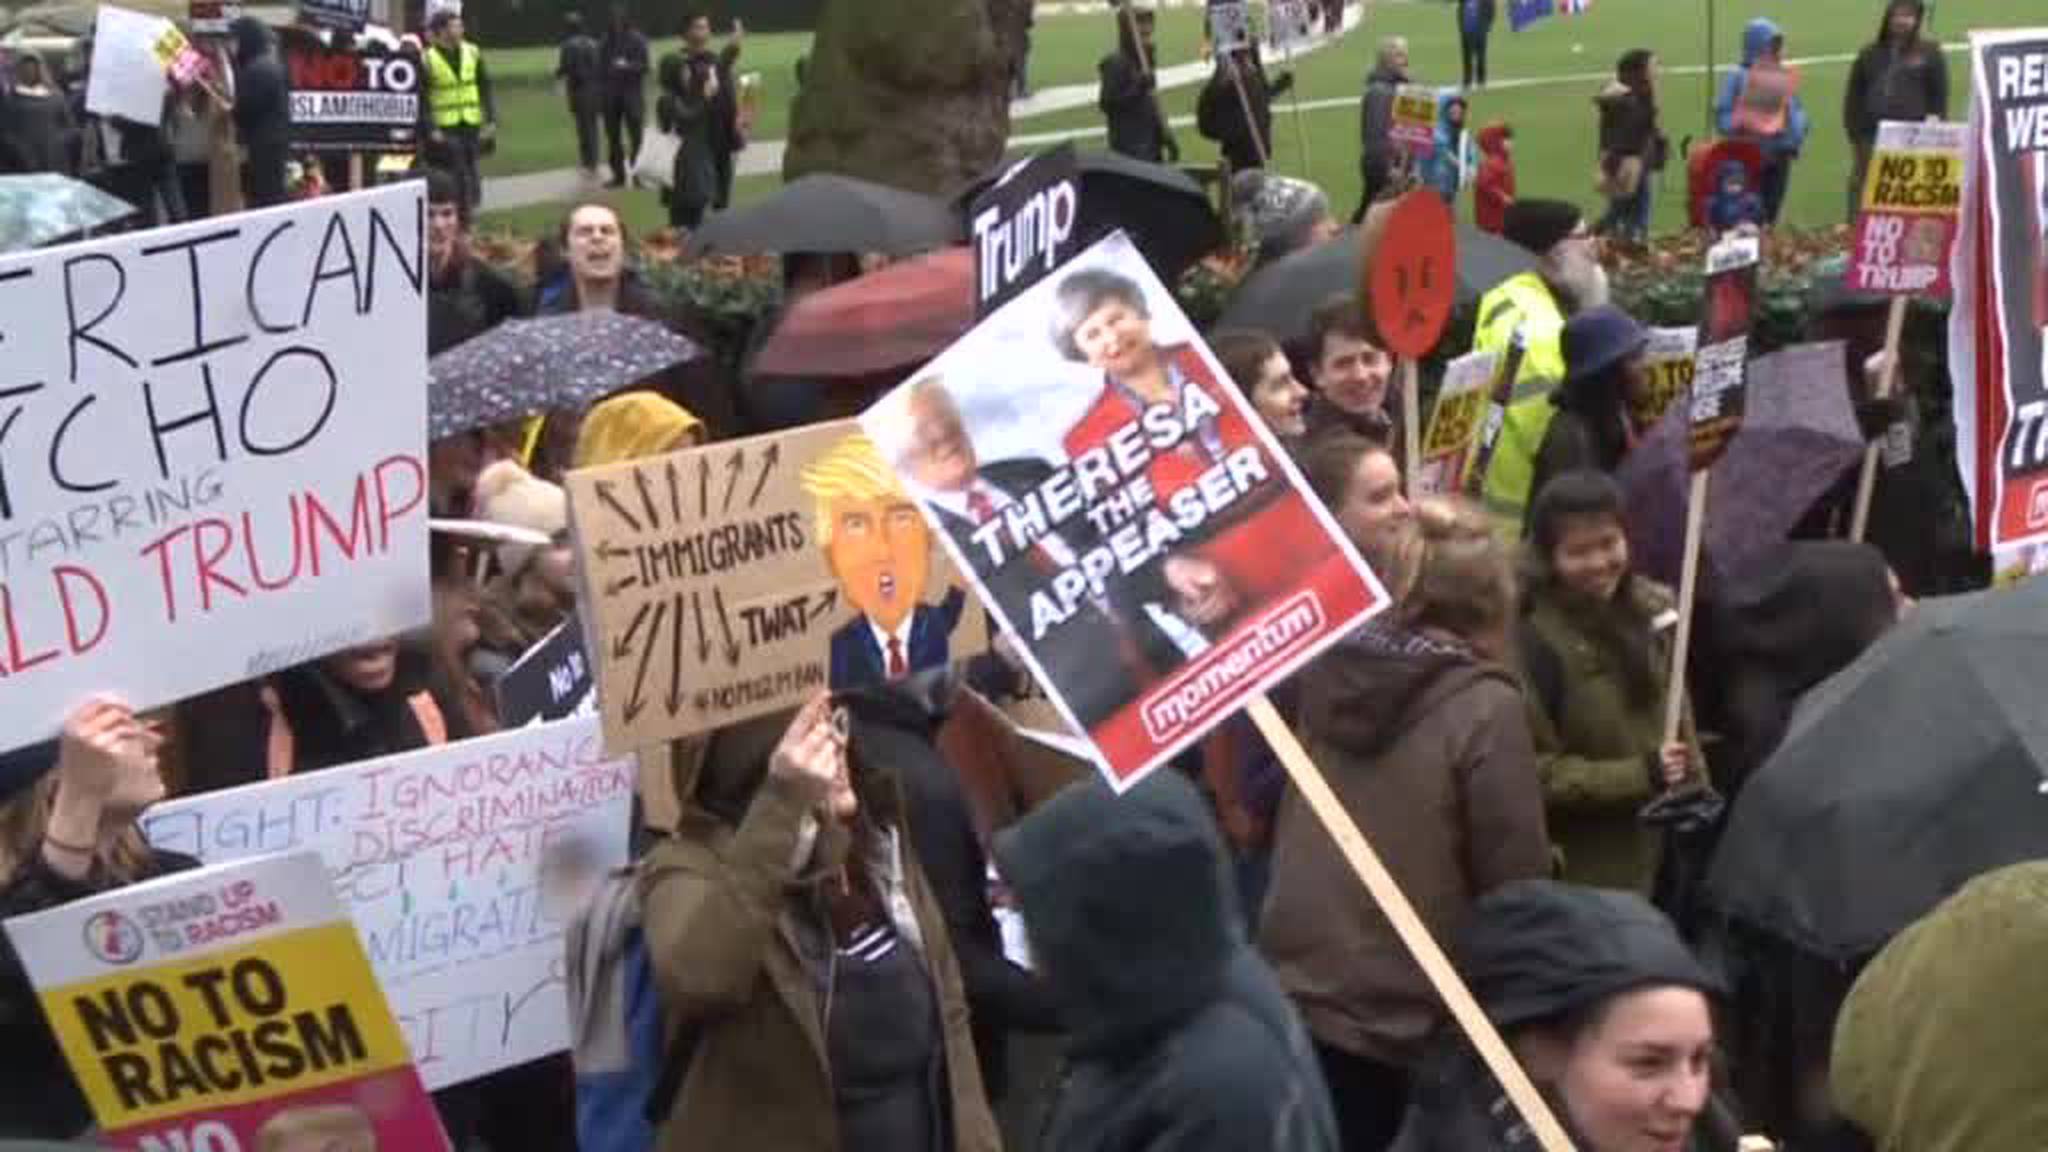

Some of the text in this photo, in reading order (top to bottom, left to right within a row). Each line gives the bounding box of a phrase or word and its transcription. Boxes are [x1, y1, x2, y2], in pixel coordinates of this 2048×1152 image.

[362, 58, 417, 91] TO
[1998, 54, 2048, 100] RE
[1880, 157, 1917, 180] NO
[975, 179, 1076, 303] Trump
[1864, 216, 1905, 243] NO
[1856, 263, 1939, 291] TRUMP
[969, 382, 1221, 570] THERESA
[1087, 474, 1156, 537] THE
[139, 454, 425, 624] TRUMP
[636, 510, 805, 588] IMMIGRANTS
[1029, 445, 1269, 642] APPEASER
[740, 595, 809, 647] TWAT
[1150, 602, 1314, 731] momentum
[184, 901, 283, 944] RACISM
[221, 880, 255, 909] UP
[72, 956, 288, 1053] NO TO
[101, 1002, 369, 1111] RACISM
